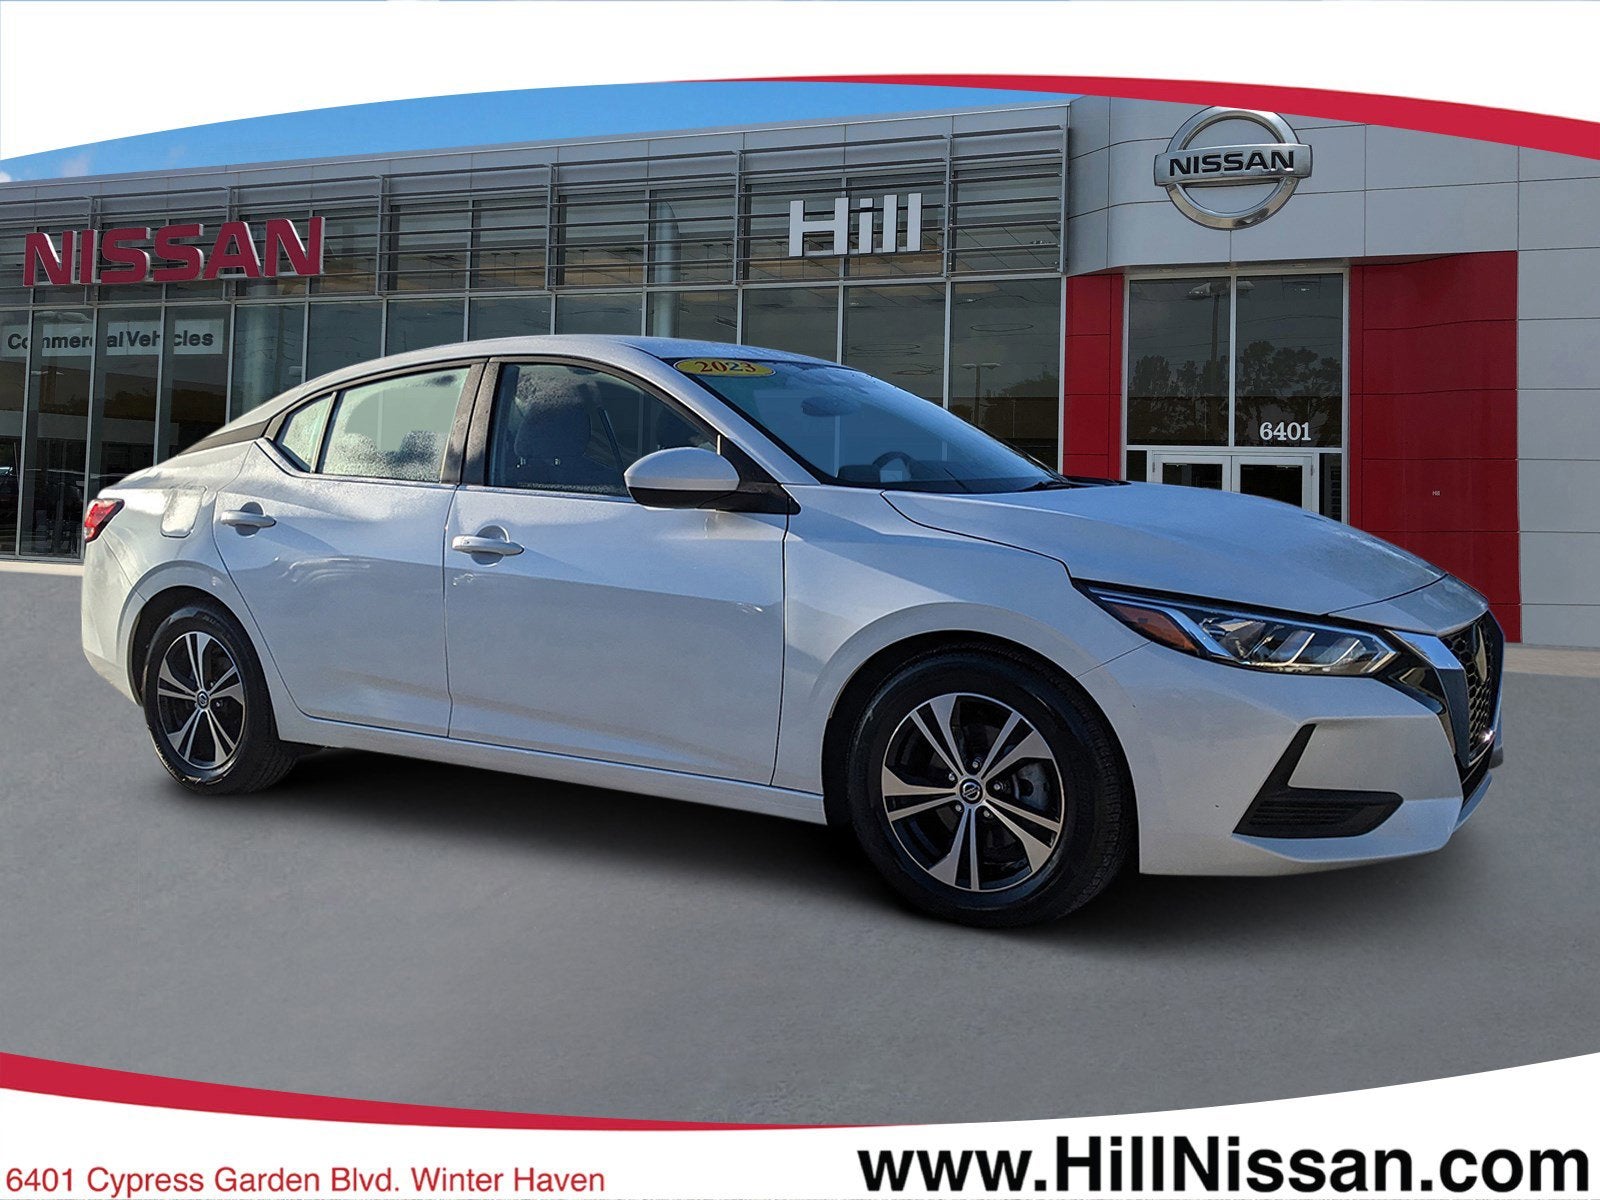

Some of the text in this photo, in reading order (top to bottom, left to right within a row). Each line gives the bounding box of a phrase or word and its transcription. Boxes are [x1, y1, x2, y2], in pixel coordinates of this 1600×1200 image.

[1169, 150, 1295, 177] NISSAN
[788, 192, 922, 257] Hill
[23, 216, 325, 287] NISSAN
[7, 329, 214, 350] Commeral Vehcles
[694, 360, 757, 373] 2023
[1259, 421, 1312, 441] 6401
